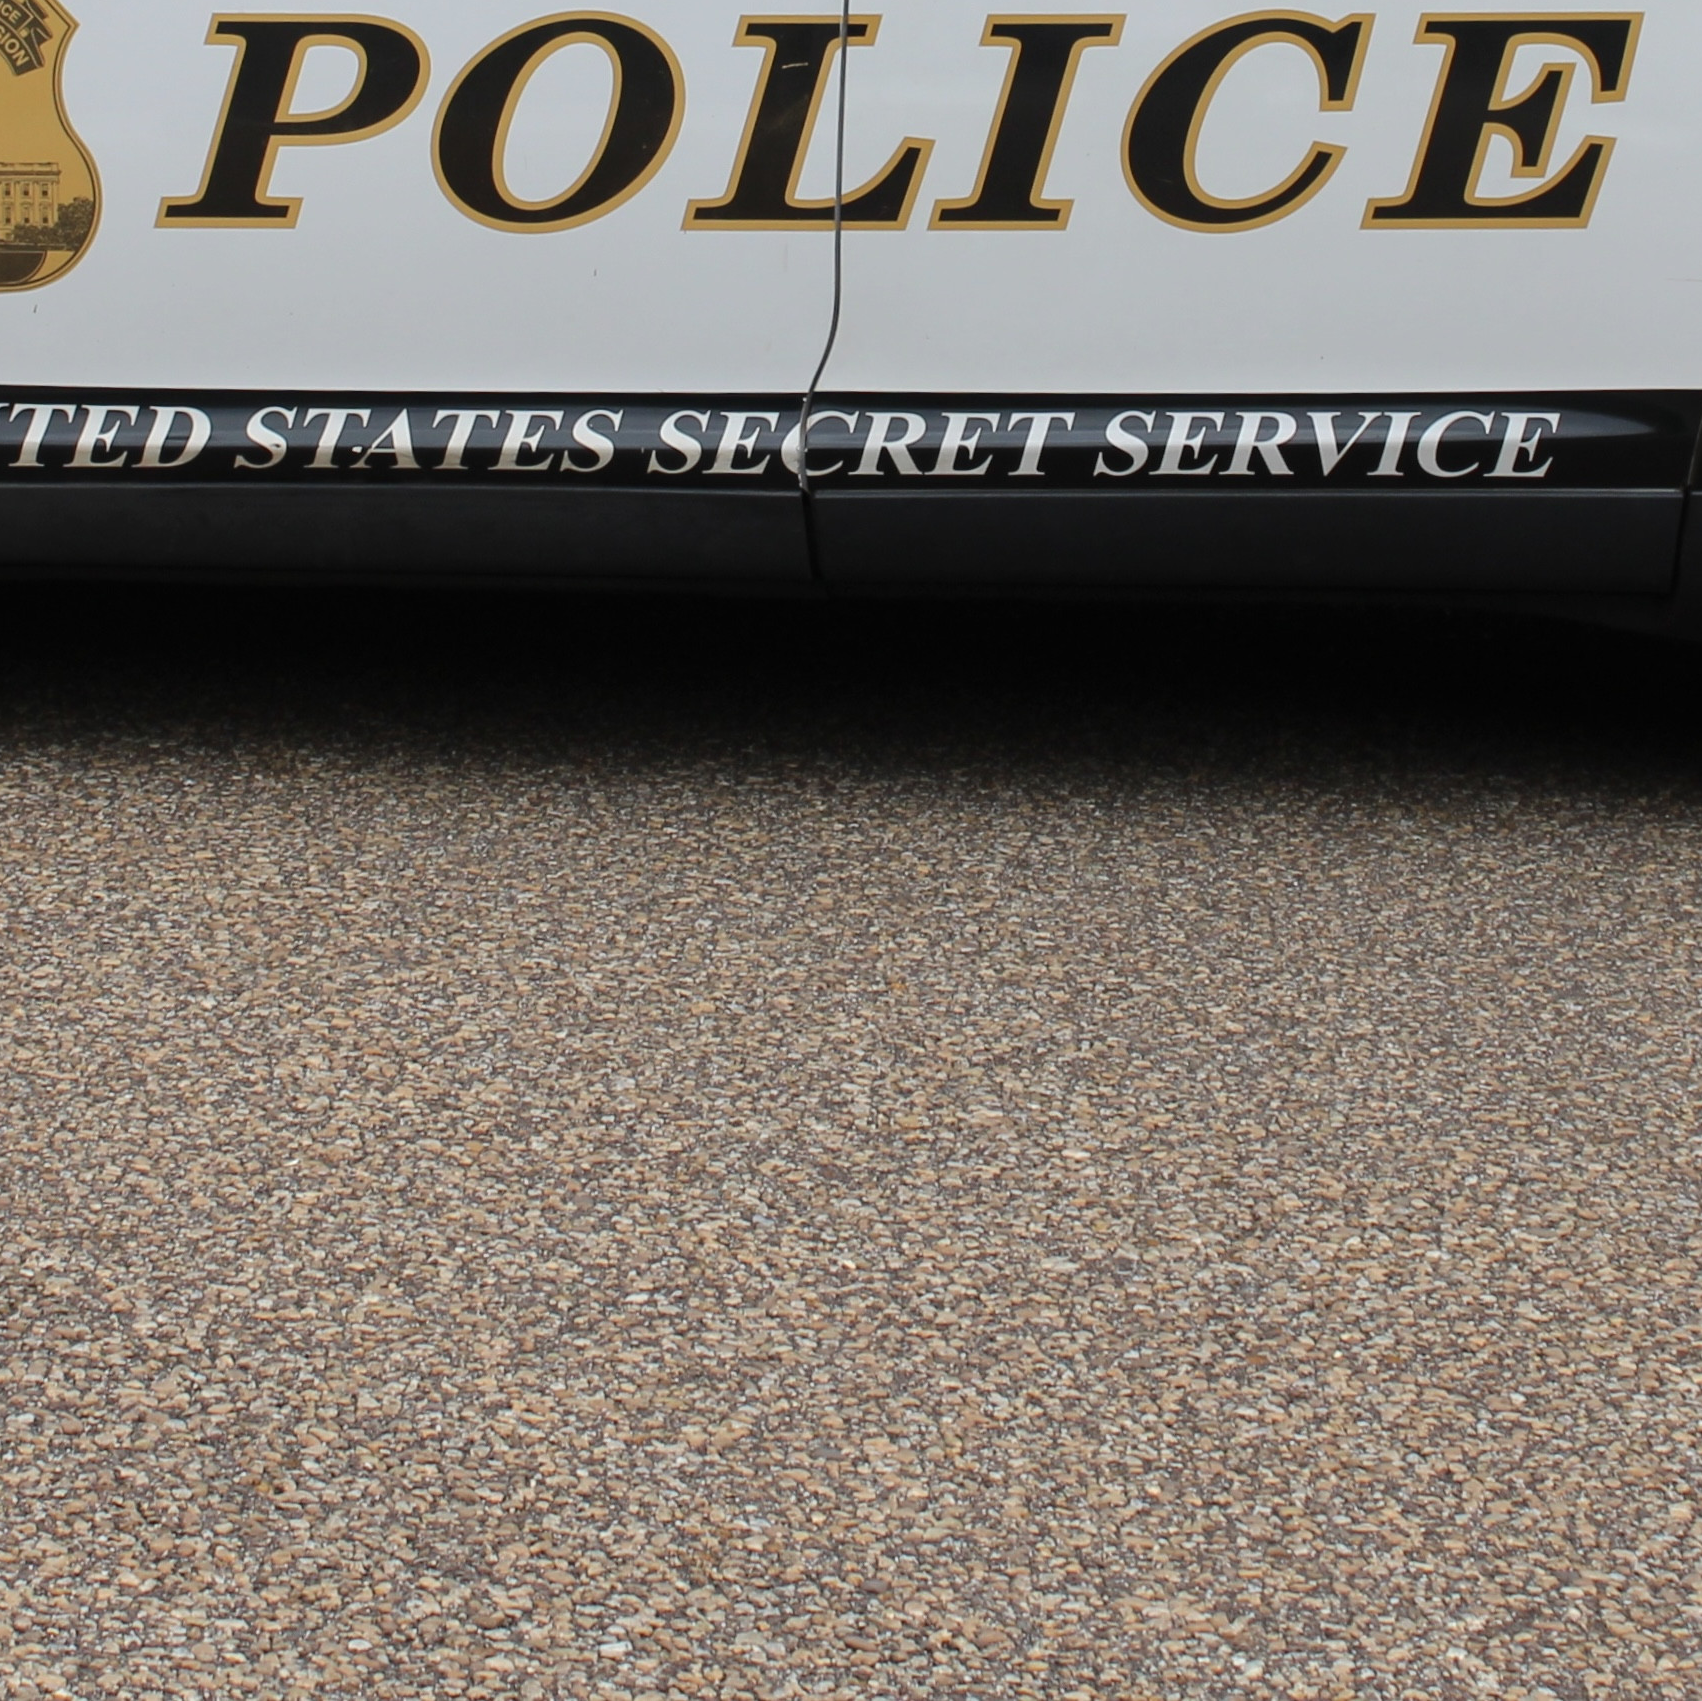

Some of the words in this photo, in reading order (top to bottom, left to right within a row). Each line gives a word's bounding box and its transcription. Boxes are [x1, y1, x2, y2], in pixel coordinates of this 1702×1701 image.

[154, 7, 1647, 234] POLICE
[234, 405, 624, 473] STATES
[647, 408, 1076, 476] SECRET
[1093, 408, 1561, 478] SERVICE
